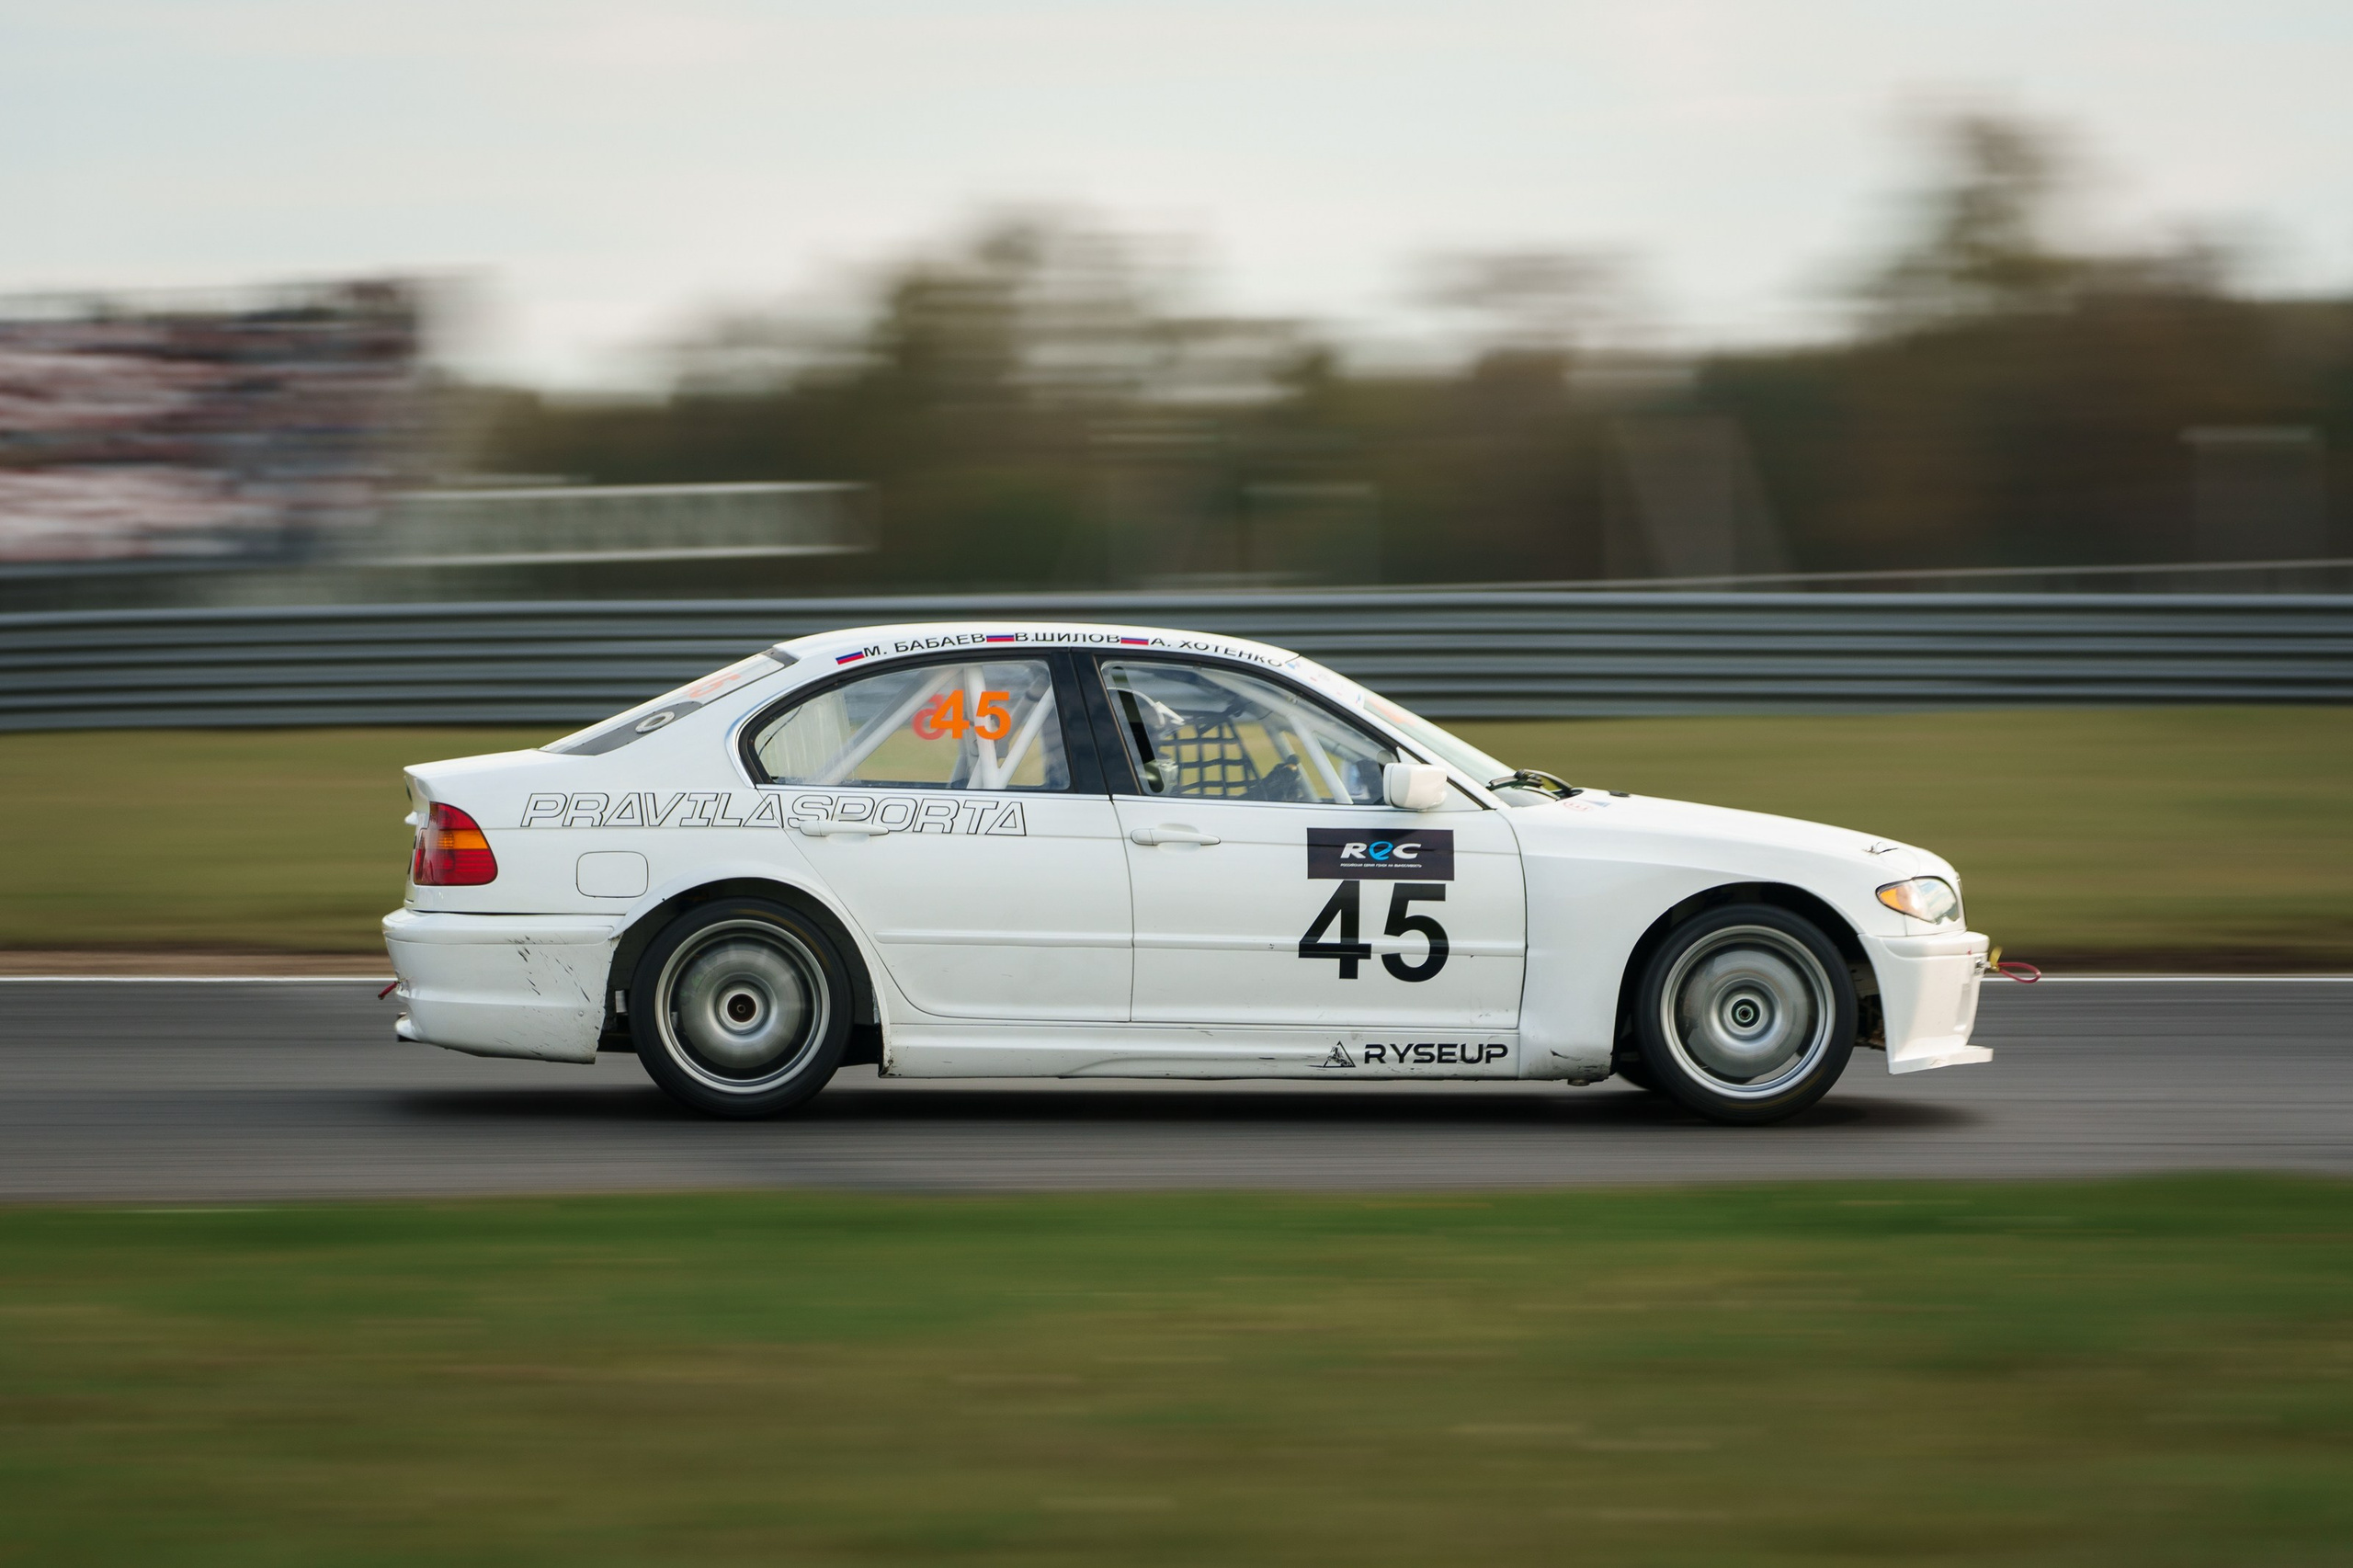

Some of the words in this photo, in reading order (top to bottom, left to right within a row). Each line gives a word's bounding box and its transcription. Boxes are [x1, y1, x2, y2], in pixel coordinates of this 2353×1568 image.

[862, 645, 888, 657] М.
[893, 632, 987, 653] БАБАЕВ
[1150, 637, 1172, 648] А.
[1178, 639, 1283, 668] ХОТЕНКО
[929, 688, 1012, 741] 45
[520, 791, 1028, 837] PRAVILASPORTA
[1298, 880, 1449, 983] 45
[1363, 1043, 1509, 1065] RYSEUP
